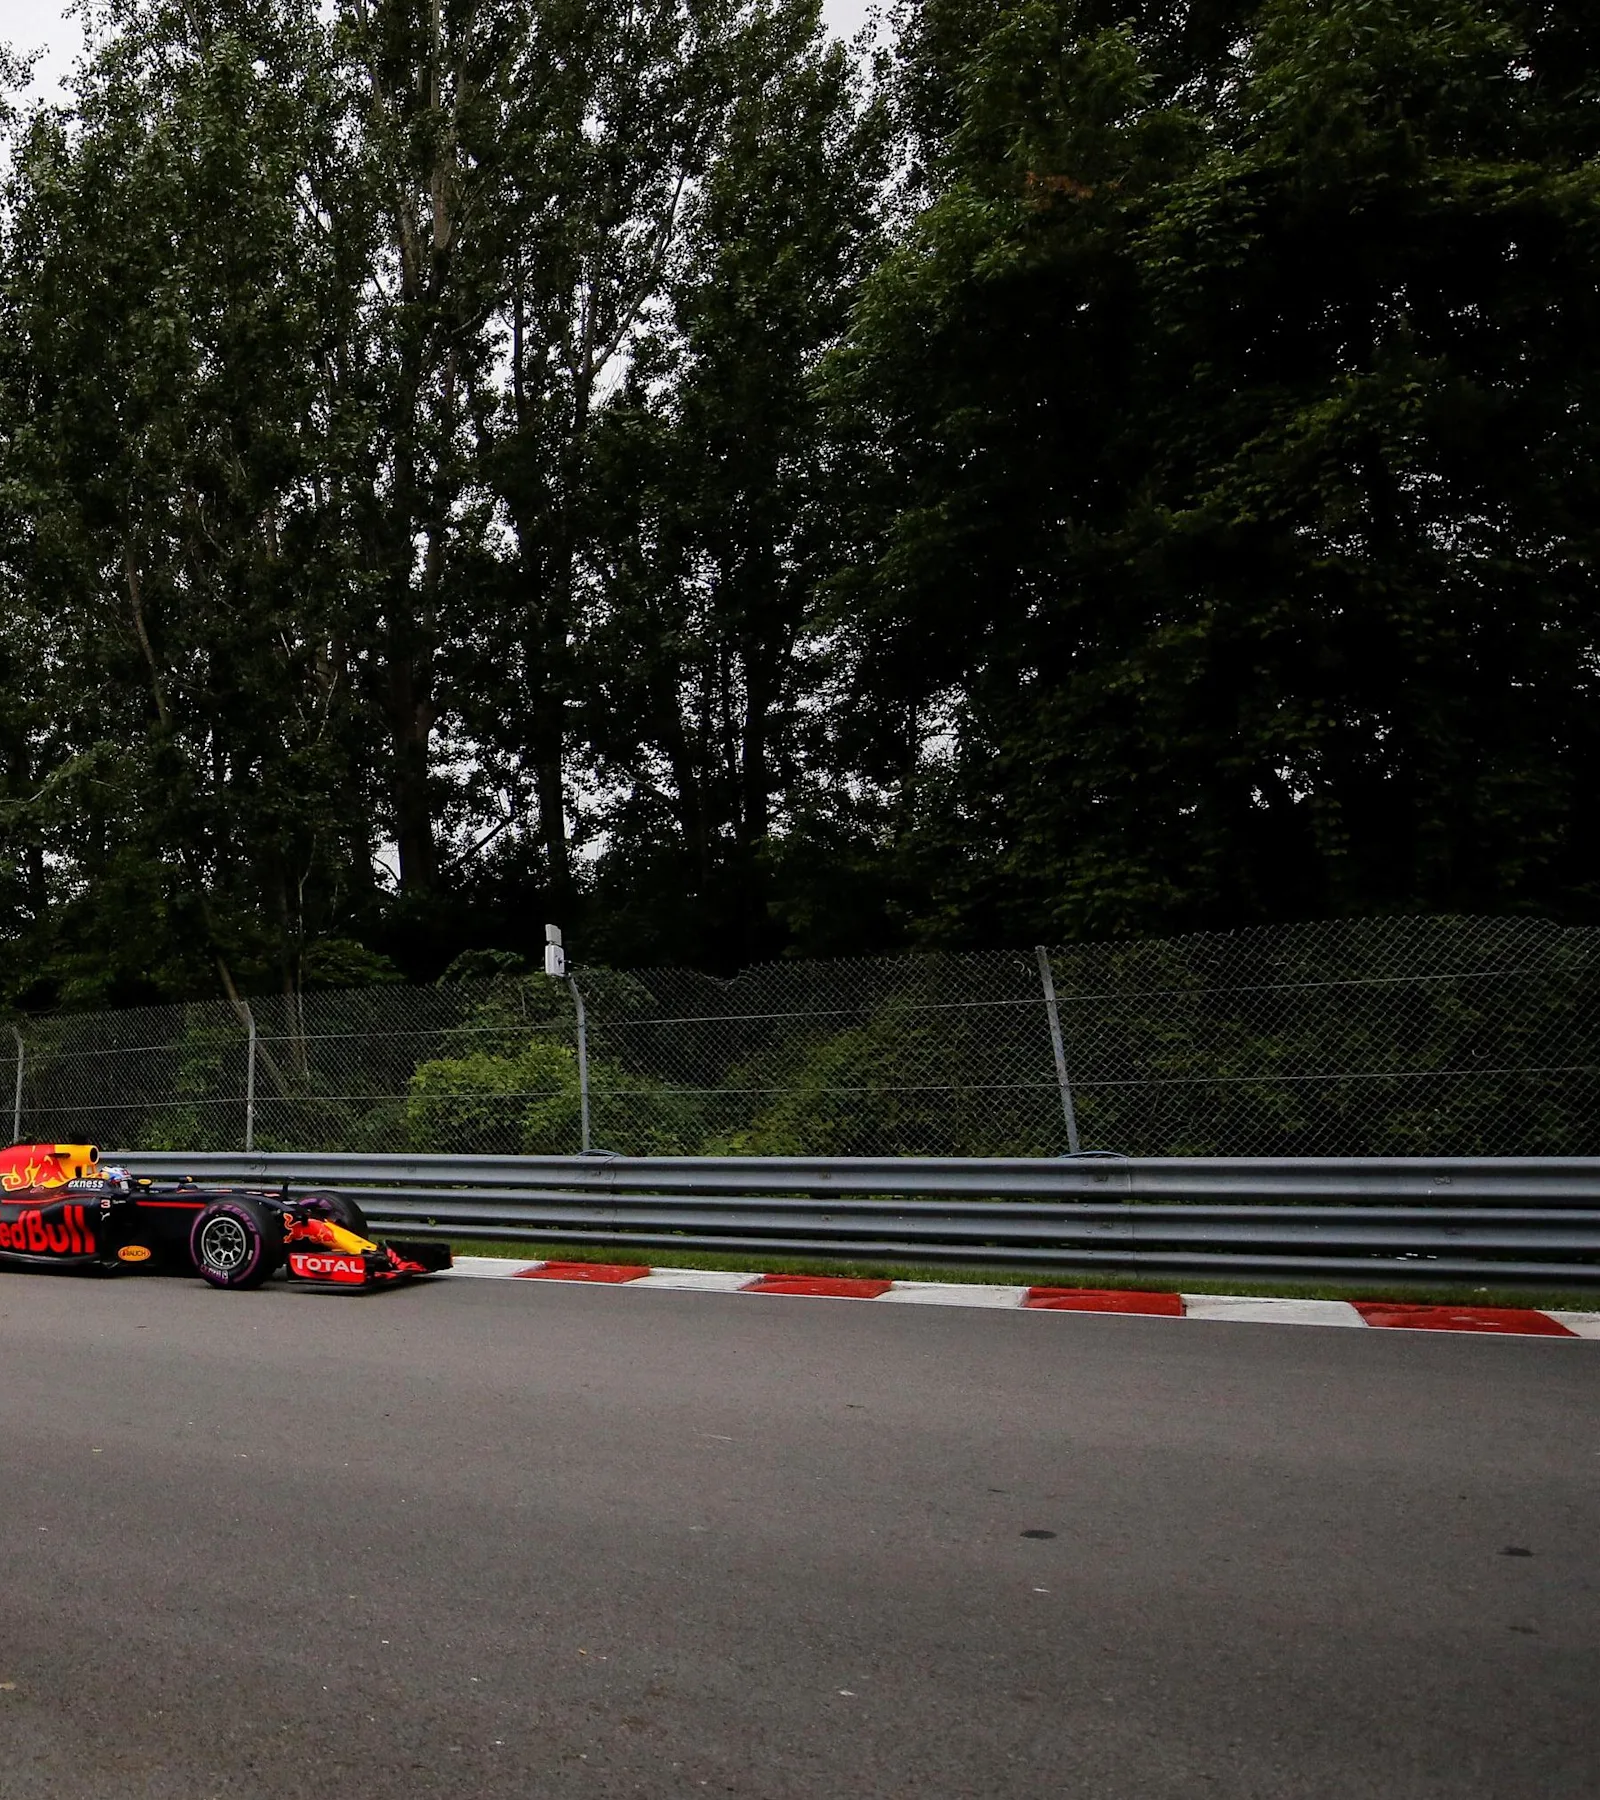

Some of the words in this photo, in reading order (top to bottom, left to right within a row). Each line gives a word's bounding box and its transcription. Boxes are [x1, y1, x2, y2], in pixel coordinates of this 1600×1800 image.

[68, 1179, 104, 1188] exness
[100, 1199, 111, 1209] 3
[292, 1255, 364, 1273] TOTAL
